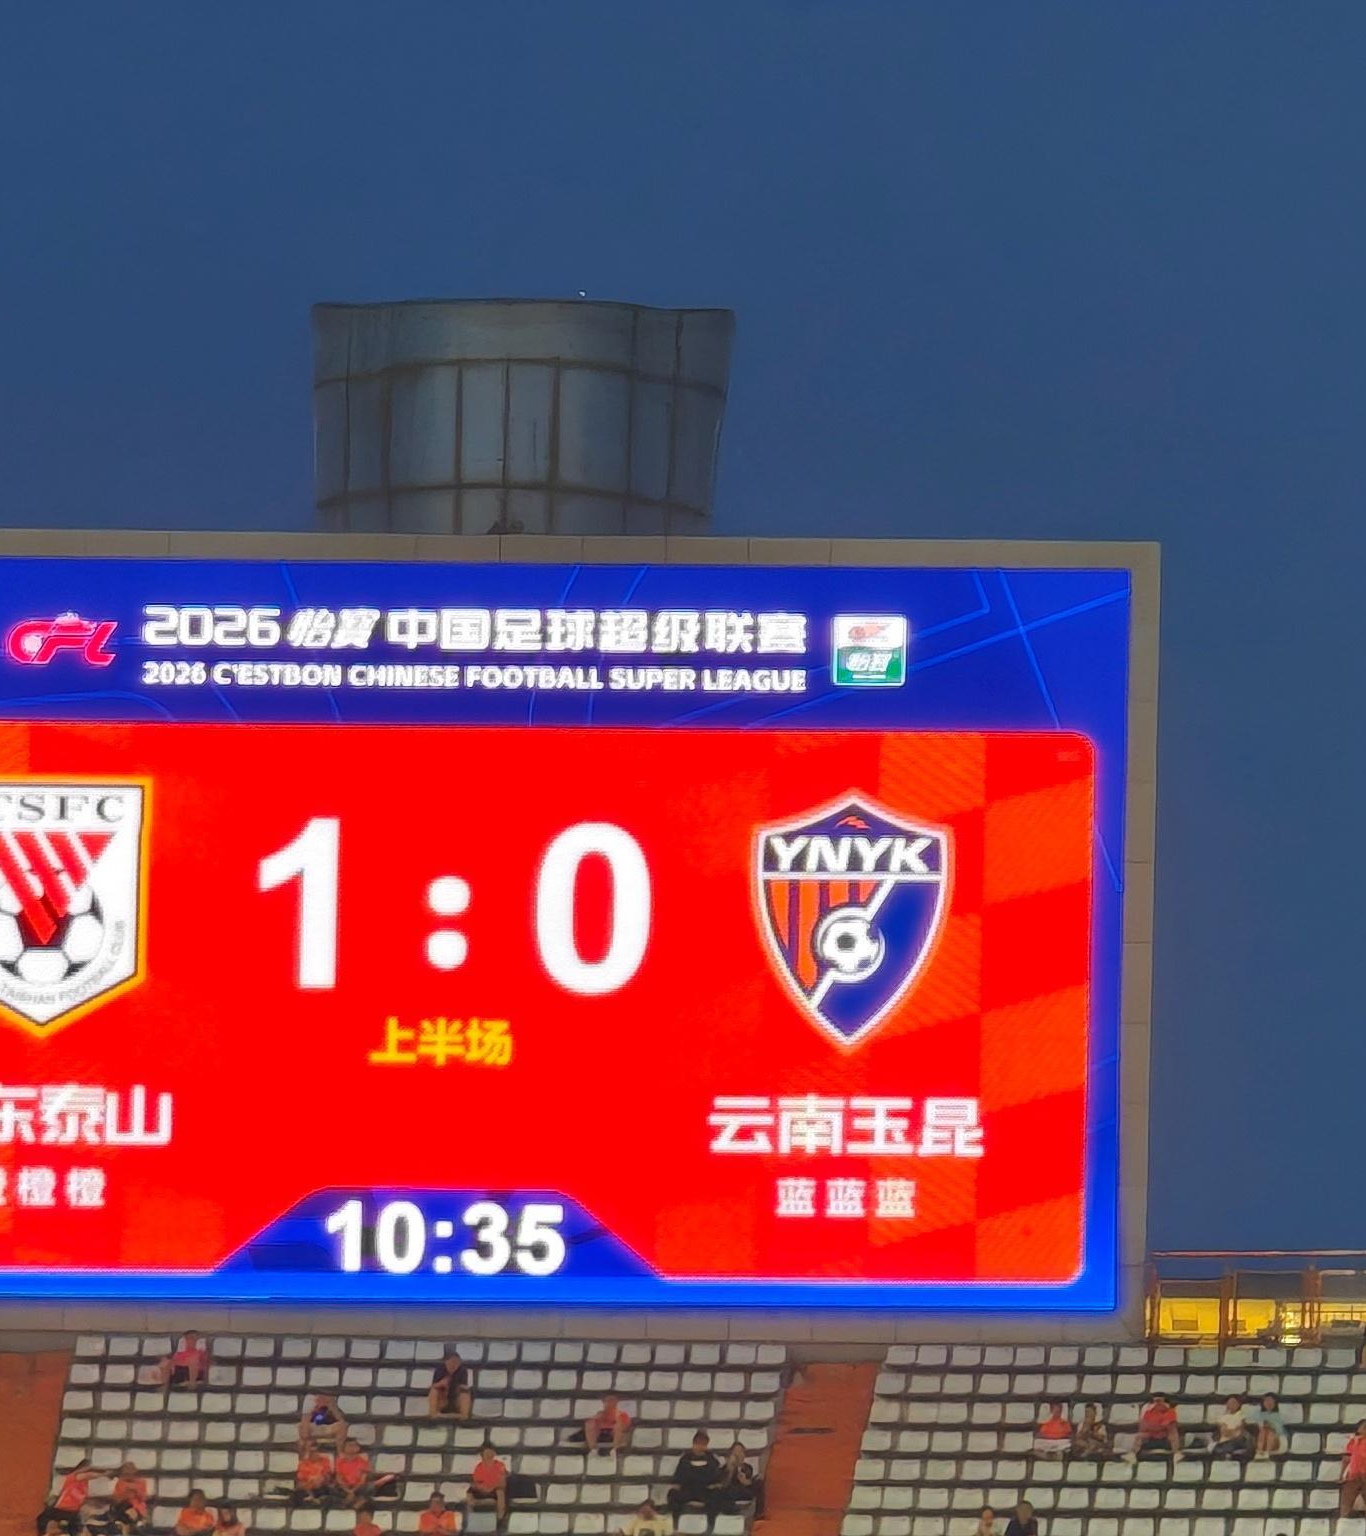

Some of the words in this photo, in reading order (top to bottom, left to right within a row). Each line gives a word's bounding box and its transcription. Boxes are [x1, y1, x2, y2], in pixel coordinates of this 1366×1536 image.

[143, 604, 281, 647] 2026
[387, 608, 807, 653] 中国足球超级联赛
[141, 660, 208, 686] 2026
[212, 662, 342, 687] C'ESTBON
[347, 664, 460, 688] CHINESE
[465, 666, 604, 690] FOOTBALL
[608, 668, 696, 691] SUPER
[701, 669, 807, 692] LEAGUE
[769, 834, 933, 873] YNYK
[368, 1016, 513, 1066] 上半场
[707, 1093, 985, 1158] 云南玉昆
[325, 1199, 567, 1277] 10:35
